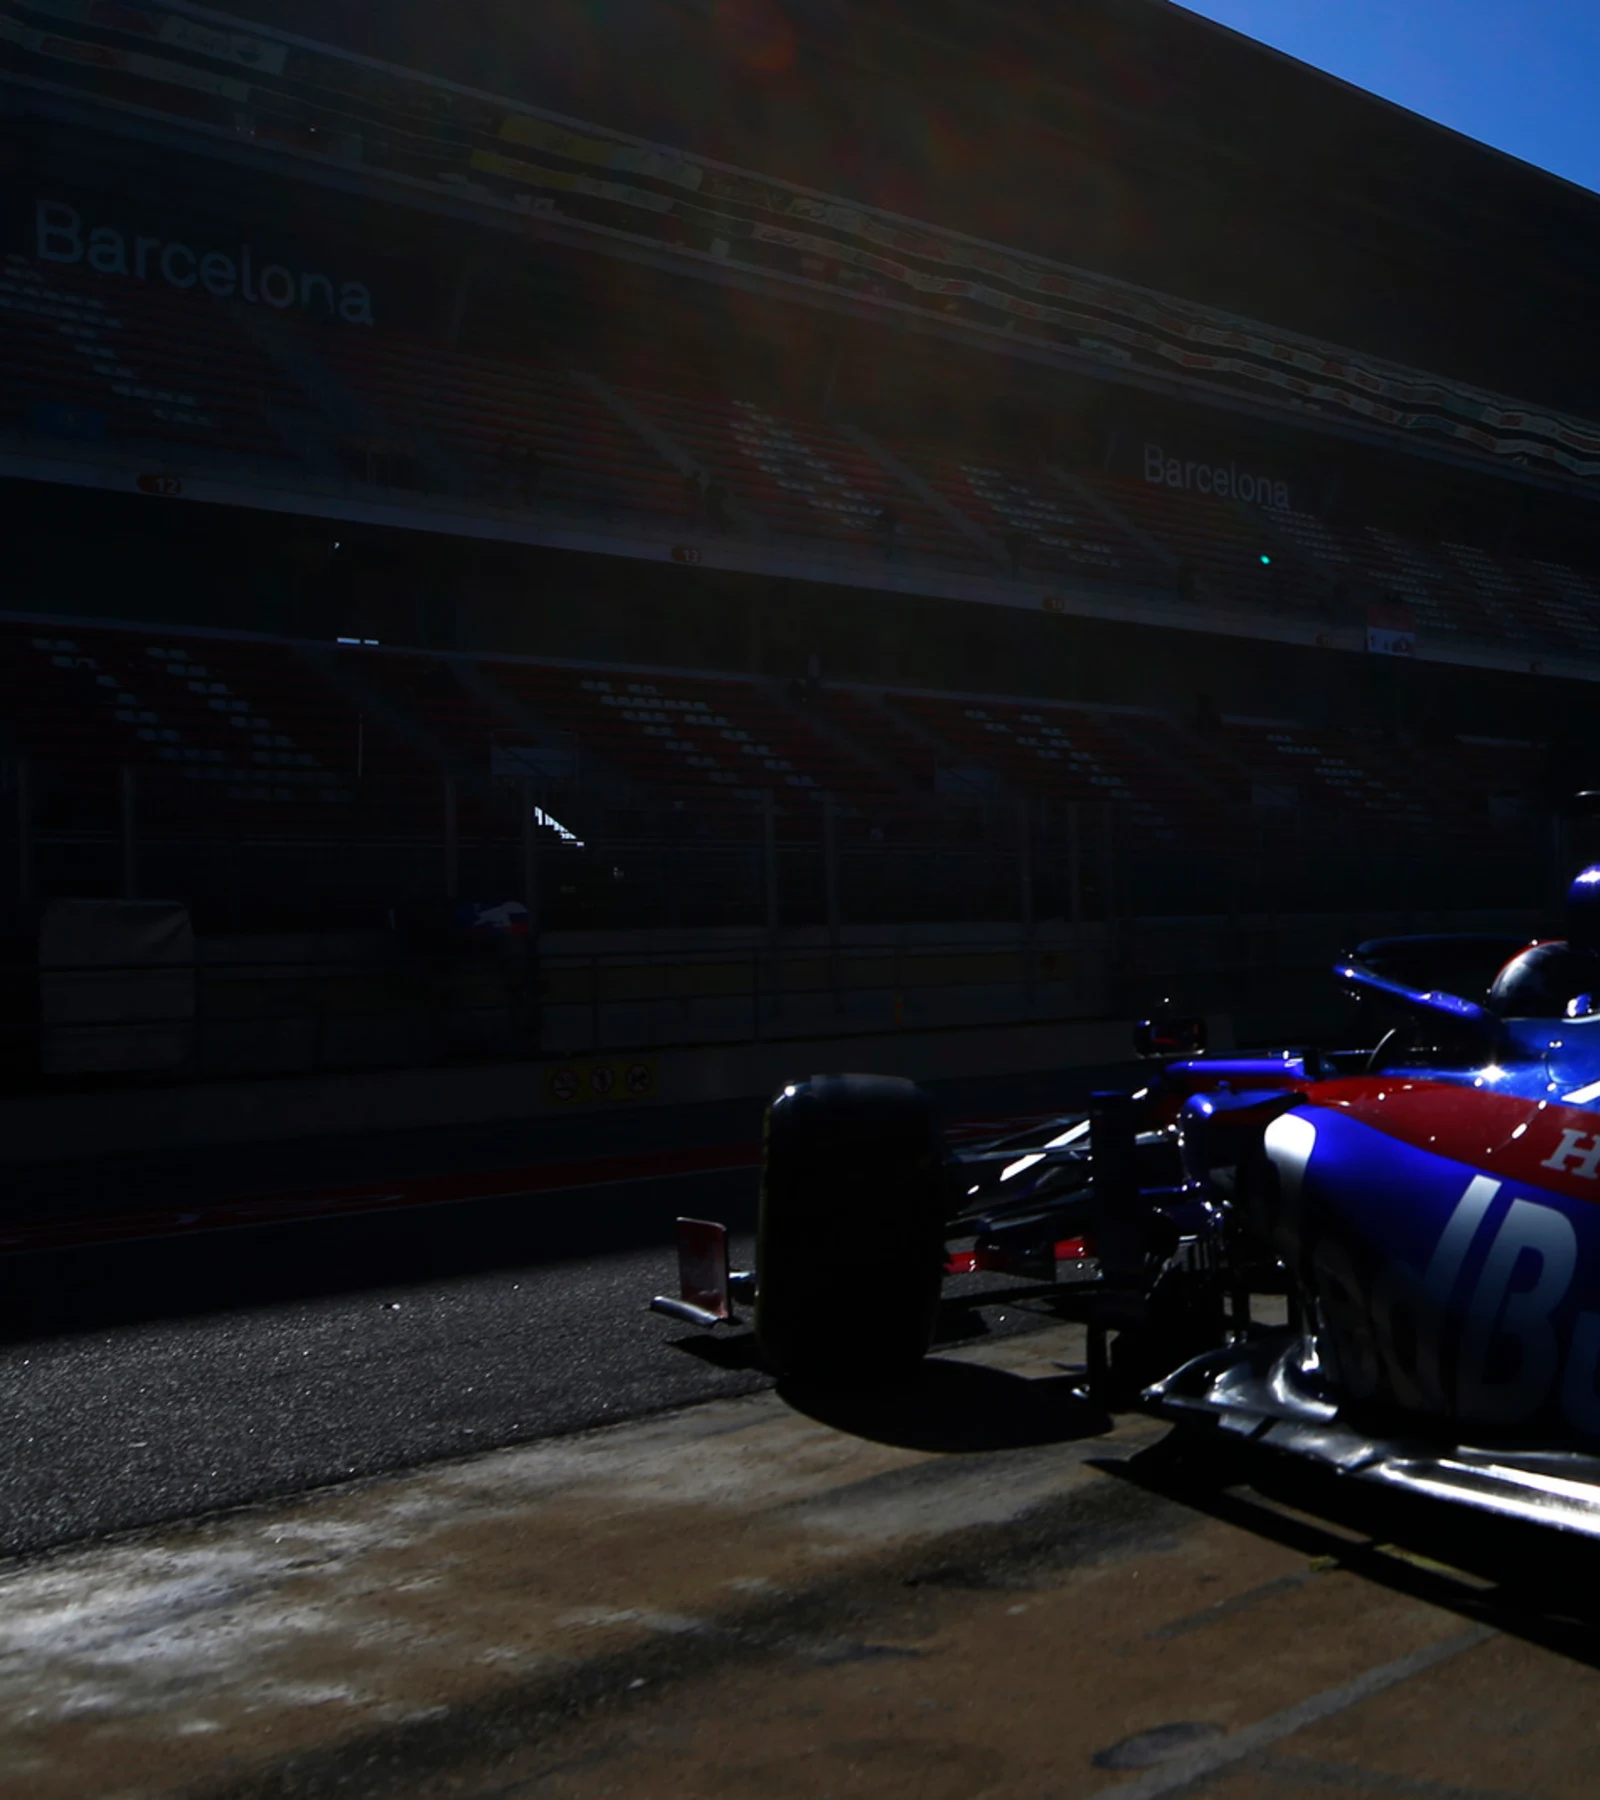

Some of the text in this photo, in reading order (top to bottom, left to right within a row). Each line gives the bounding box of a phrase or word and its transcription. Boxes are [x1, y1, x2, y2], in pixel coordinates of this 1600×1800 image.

[35, 198, 375, 328] Barcelona
[156, 476, 181, 495] 12
[1143, 442, 1290, 510] Barcelona
